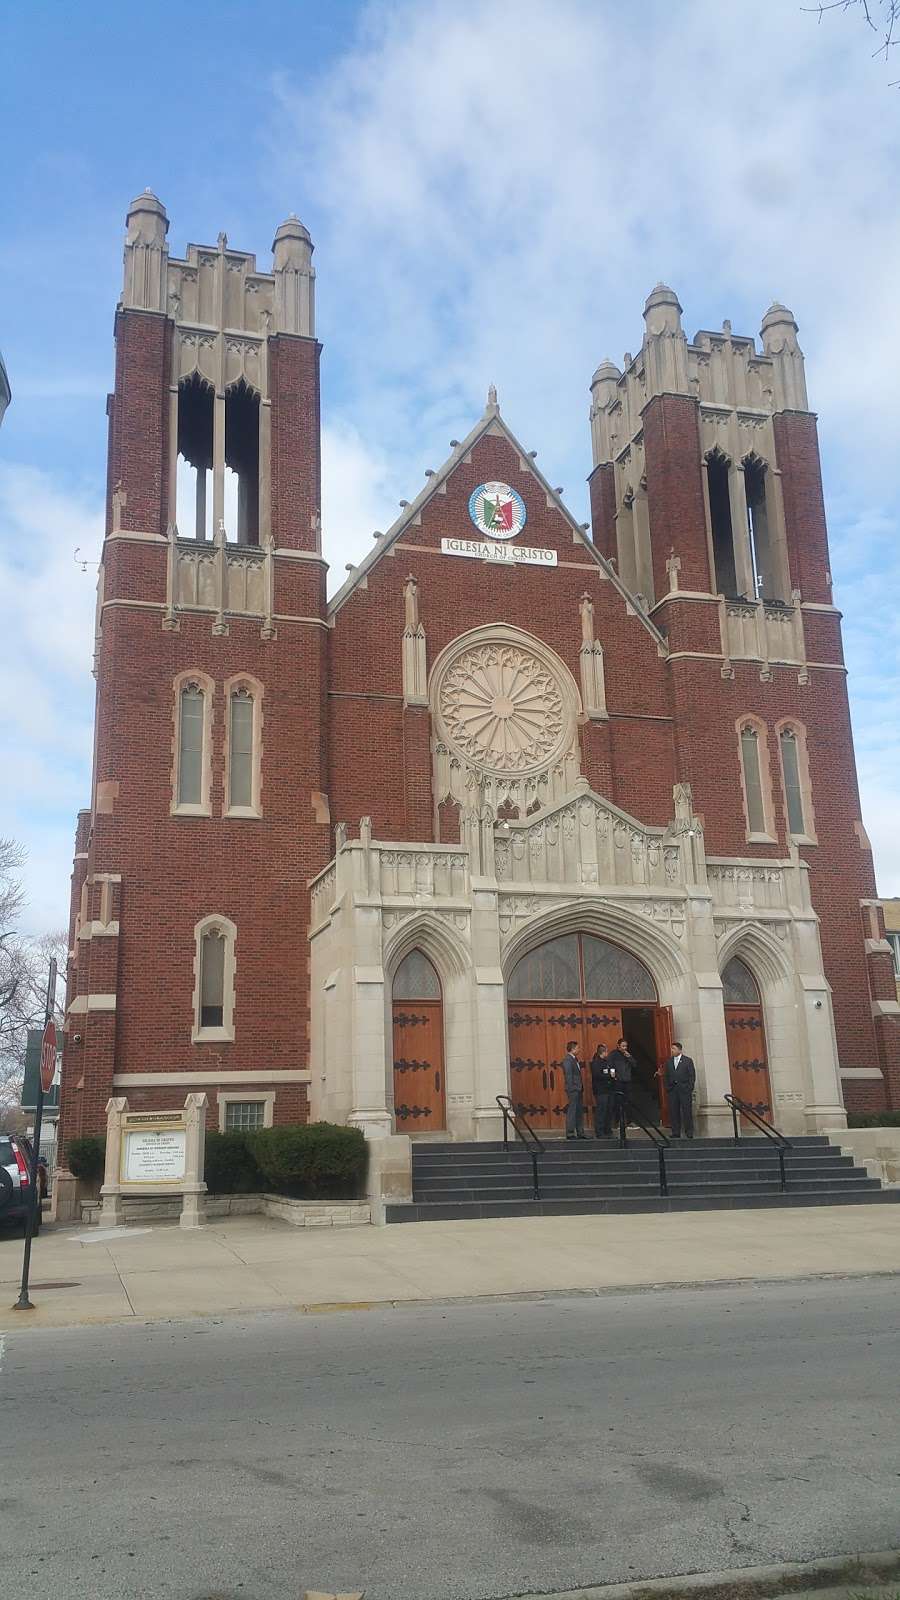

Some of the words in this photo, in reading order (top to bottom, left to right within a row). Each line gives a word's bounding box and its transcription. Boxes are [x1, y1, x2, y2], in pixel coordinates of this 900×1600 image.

[446, 540, 490, 554] IGLESIA
[494, 546, 507, 556] NI
[512, 547, 554, 561] CRISTO
[42, 1042, 56, 1070] STOP
